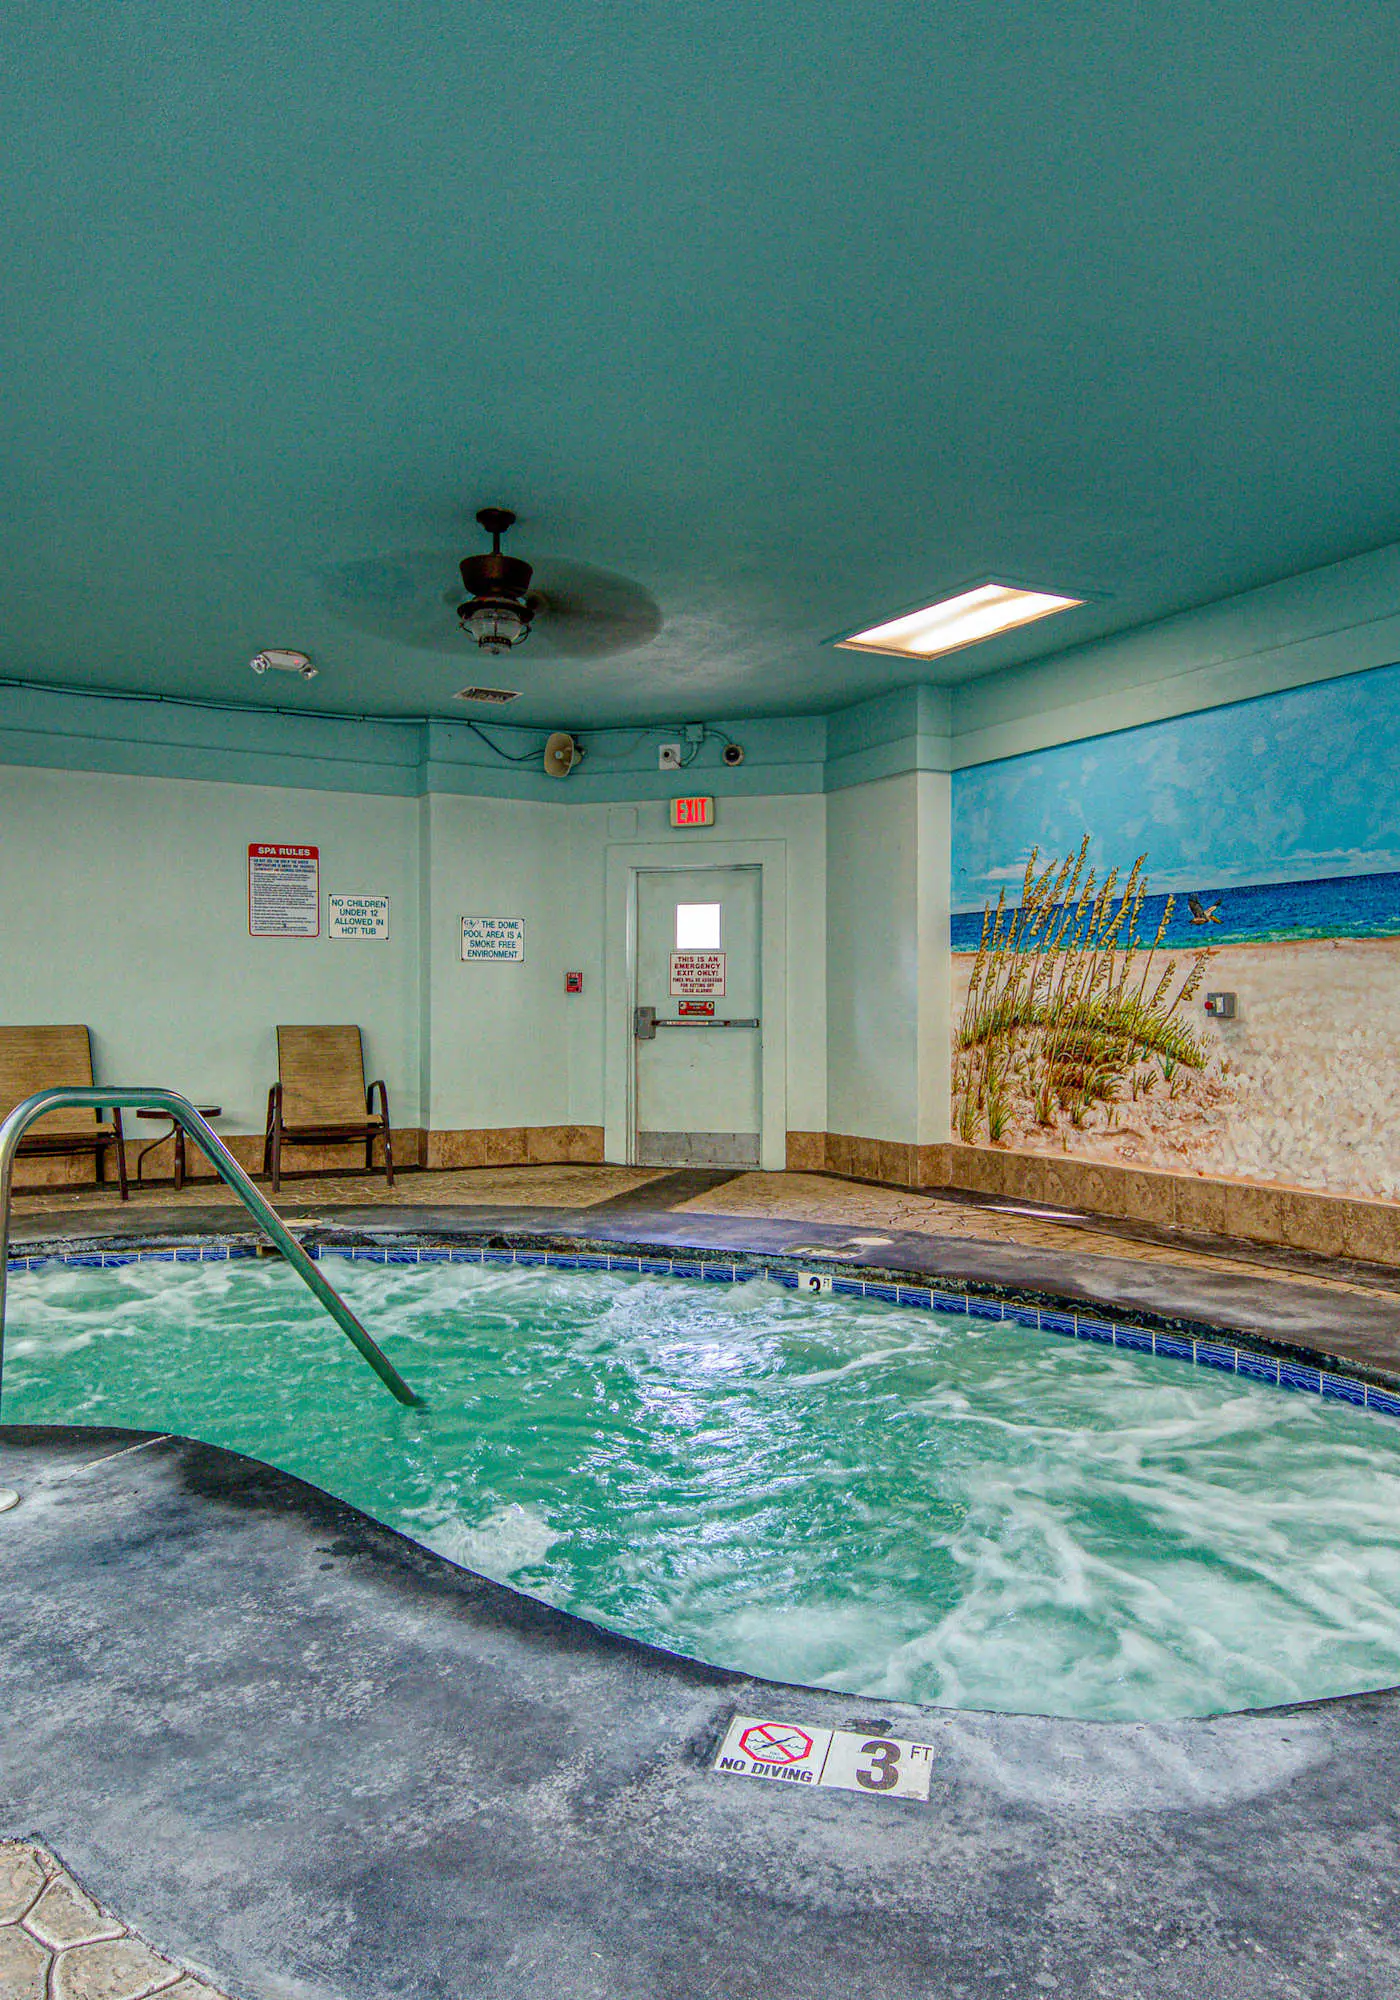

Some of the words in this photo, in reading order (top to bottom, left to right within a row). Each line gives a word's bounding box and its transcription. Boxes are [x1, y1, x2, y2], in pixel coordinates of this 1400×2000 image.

[677, 798, 707, 824] EXIT
[258, 847, 276, 855] SPA
[279, 848, 310, 856] RULES
[331, 899, 344, 907] NO
[347, 899, 386, 908] CHILDREN
[340, 909, 367, 917] UNDER
[370, 909, 379, 917] 12
[335, 917, 373, 926] ALLOWED
[375, 918, 384, 926] IN
[481, 920, 495, 929] THE
[498, 921, 519, 930] DOME
[341, 926, 357, 935] HOT
[361, 927, 377, 935] TUB
[463, 929, 484, 938] POOL
[486, 930, 506, 939] AREA
[507, 931, 515, 939] IS
[516, 931, 522, 939] A
[470, 939, 496, 948] SMOKE
[498, 940, 517, 949] FREE
[467, 949, 519, 959] ENVIRONMENT
[720, 1756, 746, 1771] NO
[751, 1762, 814, 1783] DIVING
[856, 1740, 901, 1791] 3
[911, 1745, 933, 1761] FT
